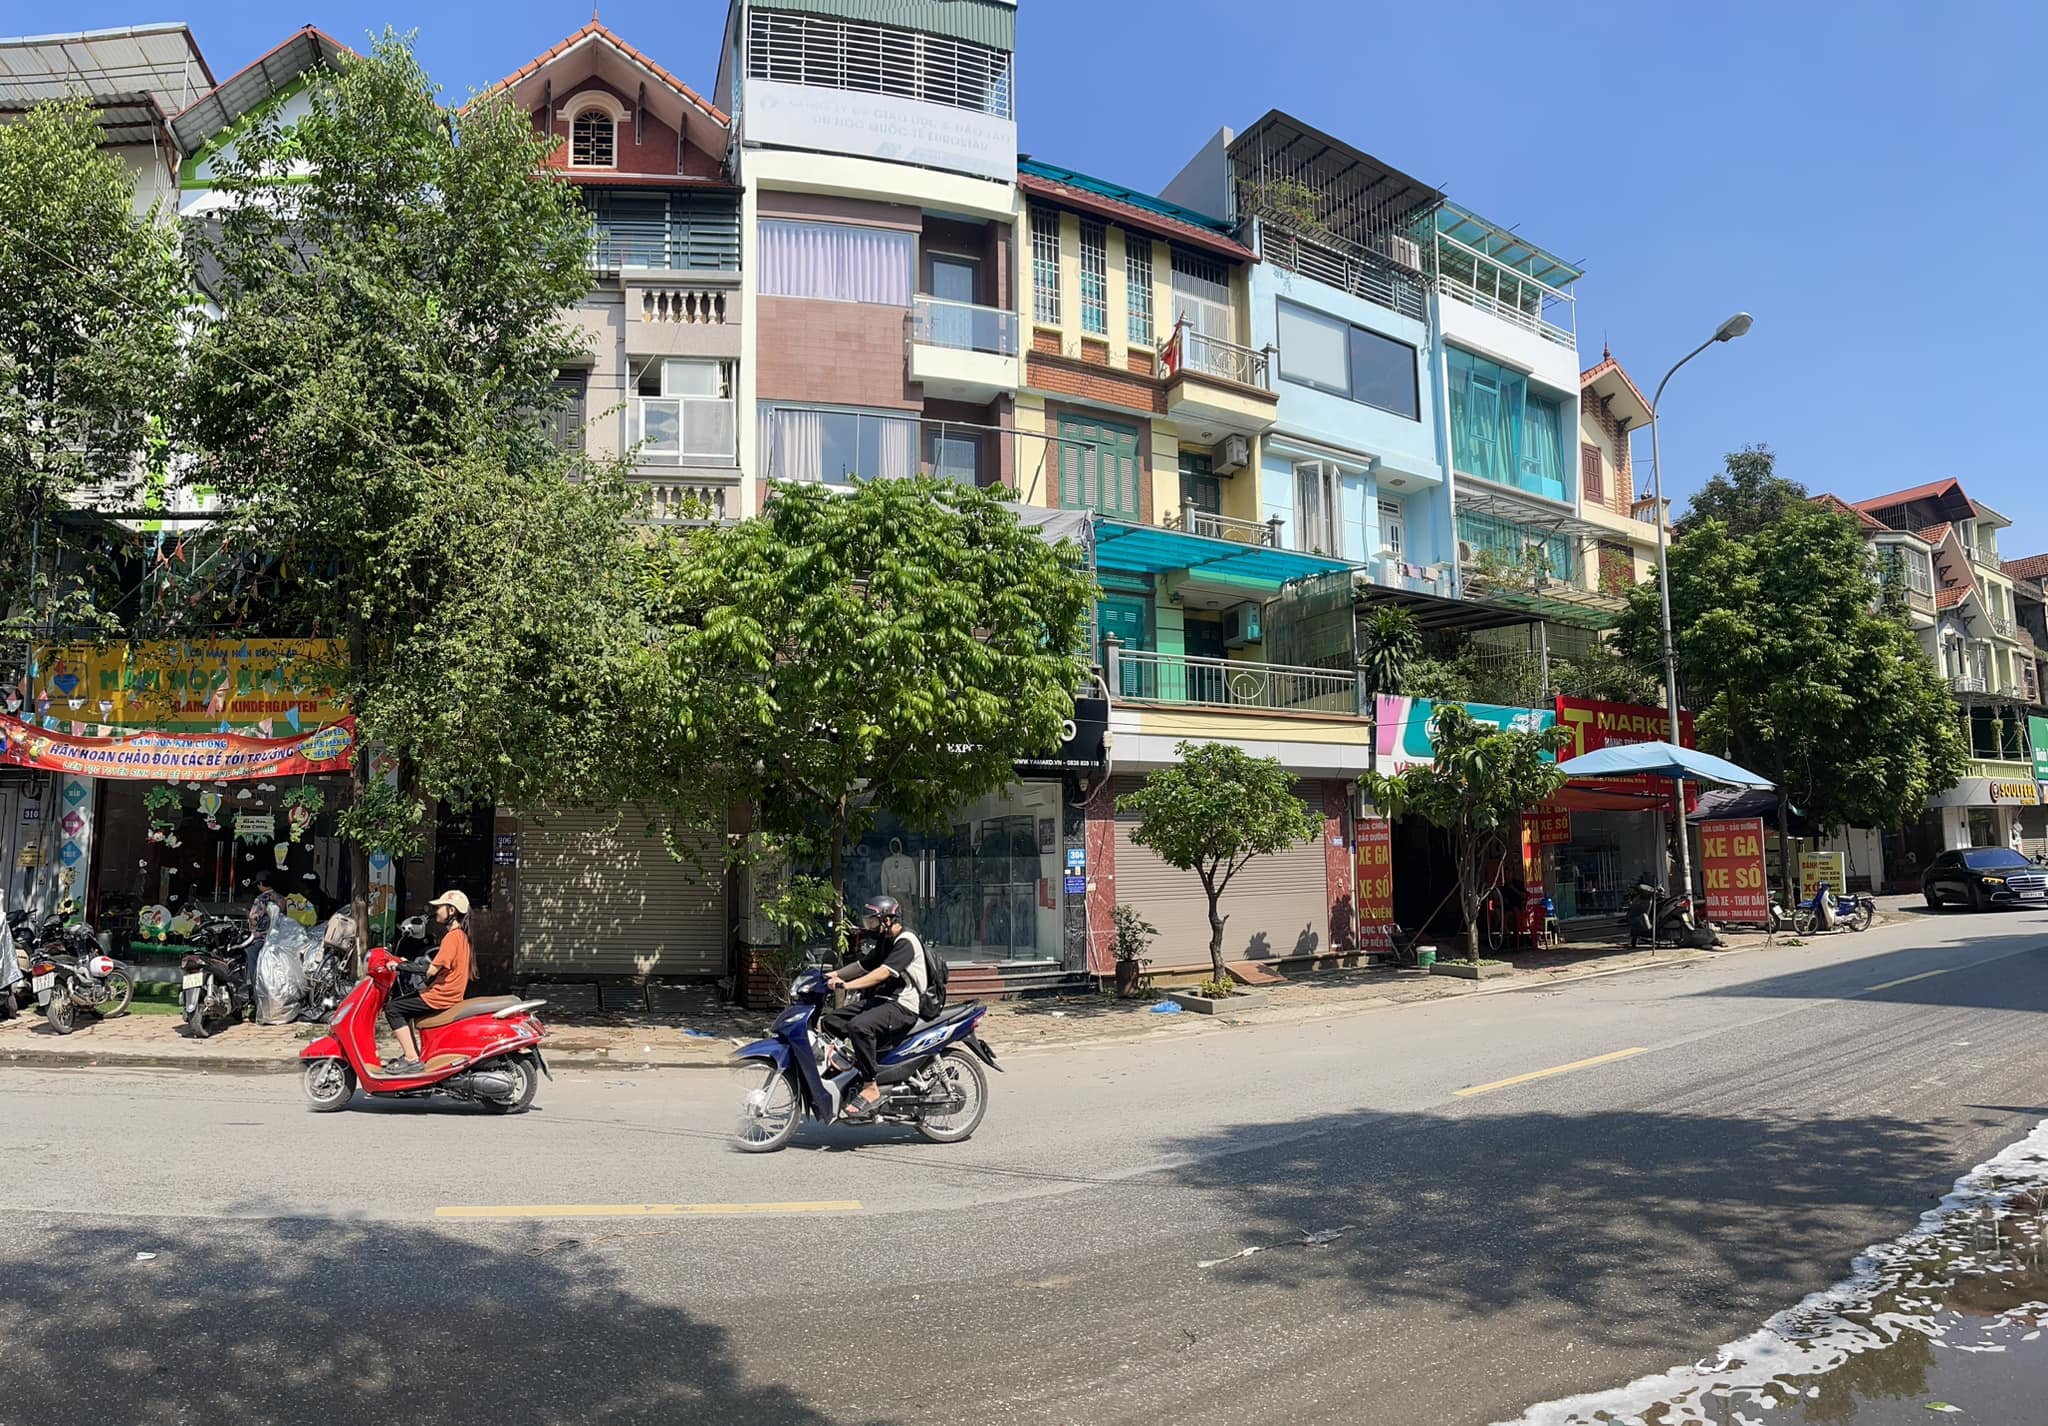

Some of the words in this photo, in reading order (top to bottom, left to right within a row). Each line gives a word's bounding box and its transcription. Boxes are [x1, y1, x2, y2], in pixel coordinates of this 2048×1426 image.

[1564, 708, 1593, 757] T
[80, 748, 116, 763] HOAN
[151, 750, 179, 766] ĐÓN
[181, 750, 204, 767] CÁC
[206, 750, 222, 766] BÉ
[1541, 820, 1553, 830] XE
[1555, 816, 1568, 829] SỐ
[1359, 846, 1372, 865] XE
[1375, 845, 1389, 865] GA
[1704, 838, 1728, 857] XE
[1733, 835, 1760, 857] GA
[1706, 868, 1730, 888] XE
[1735, 860, 1761, 888] SỐ
[1360, 880, 1373, 898] XE
[1375, 872, 1389, 898] SỐ
[1720, 896, 1729, 906] XE
[1734, 896, 1750, 906] THAY
